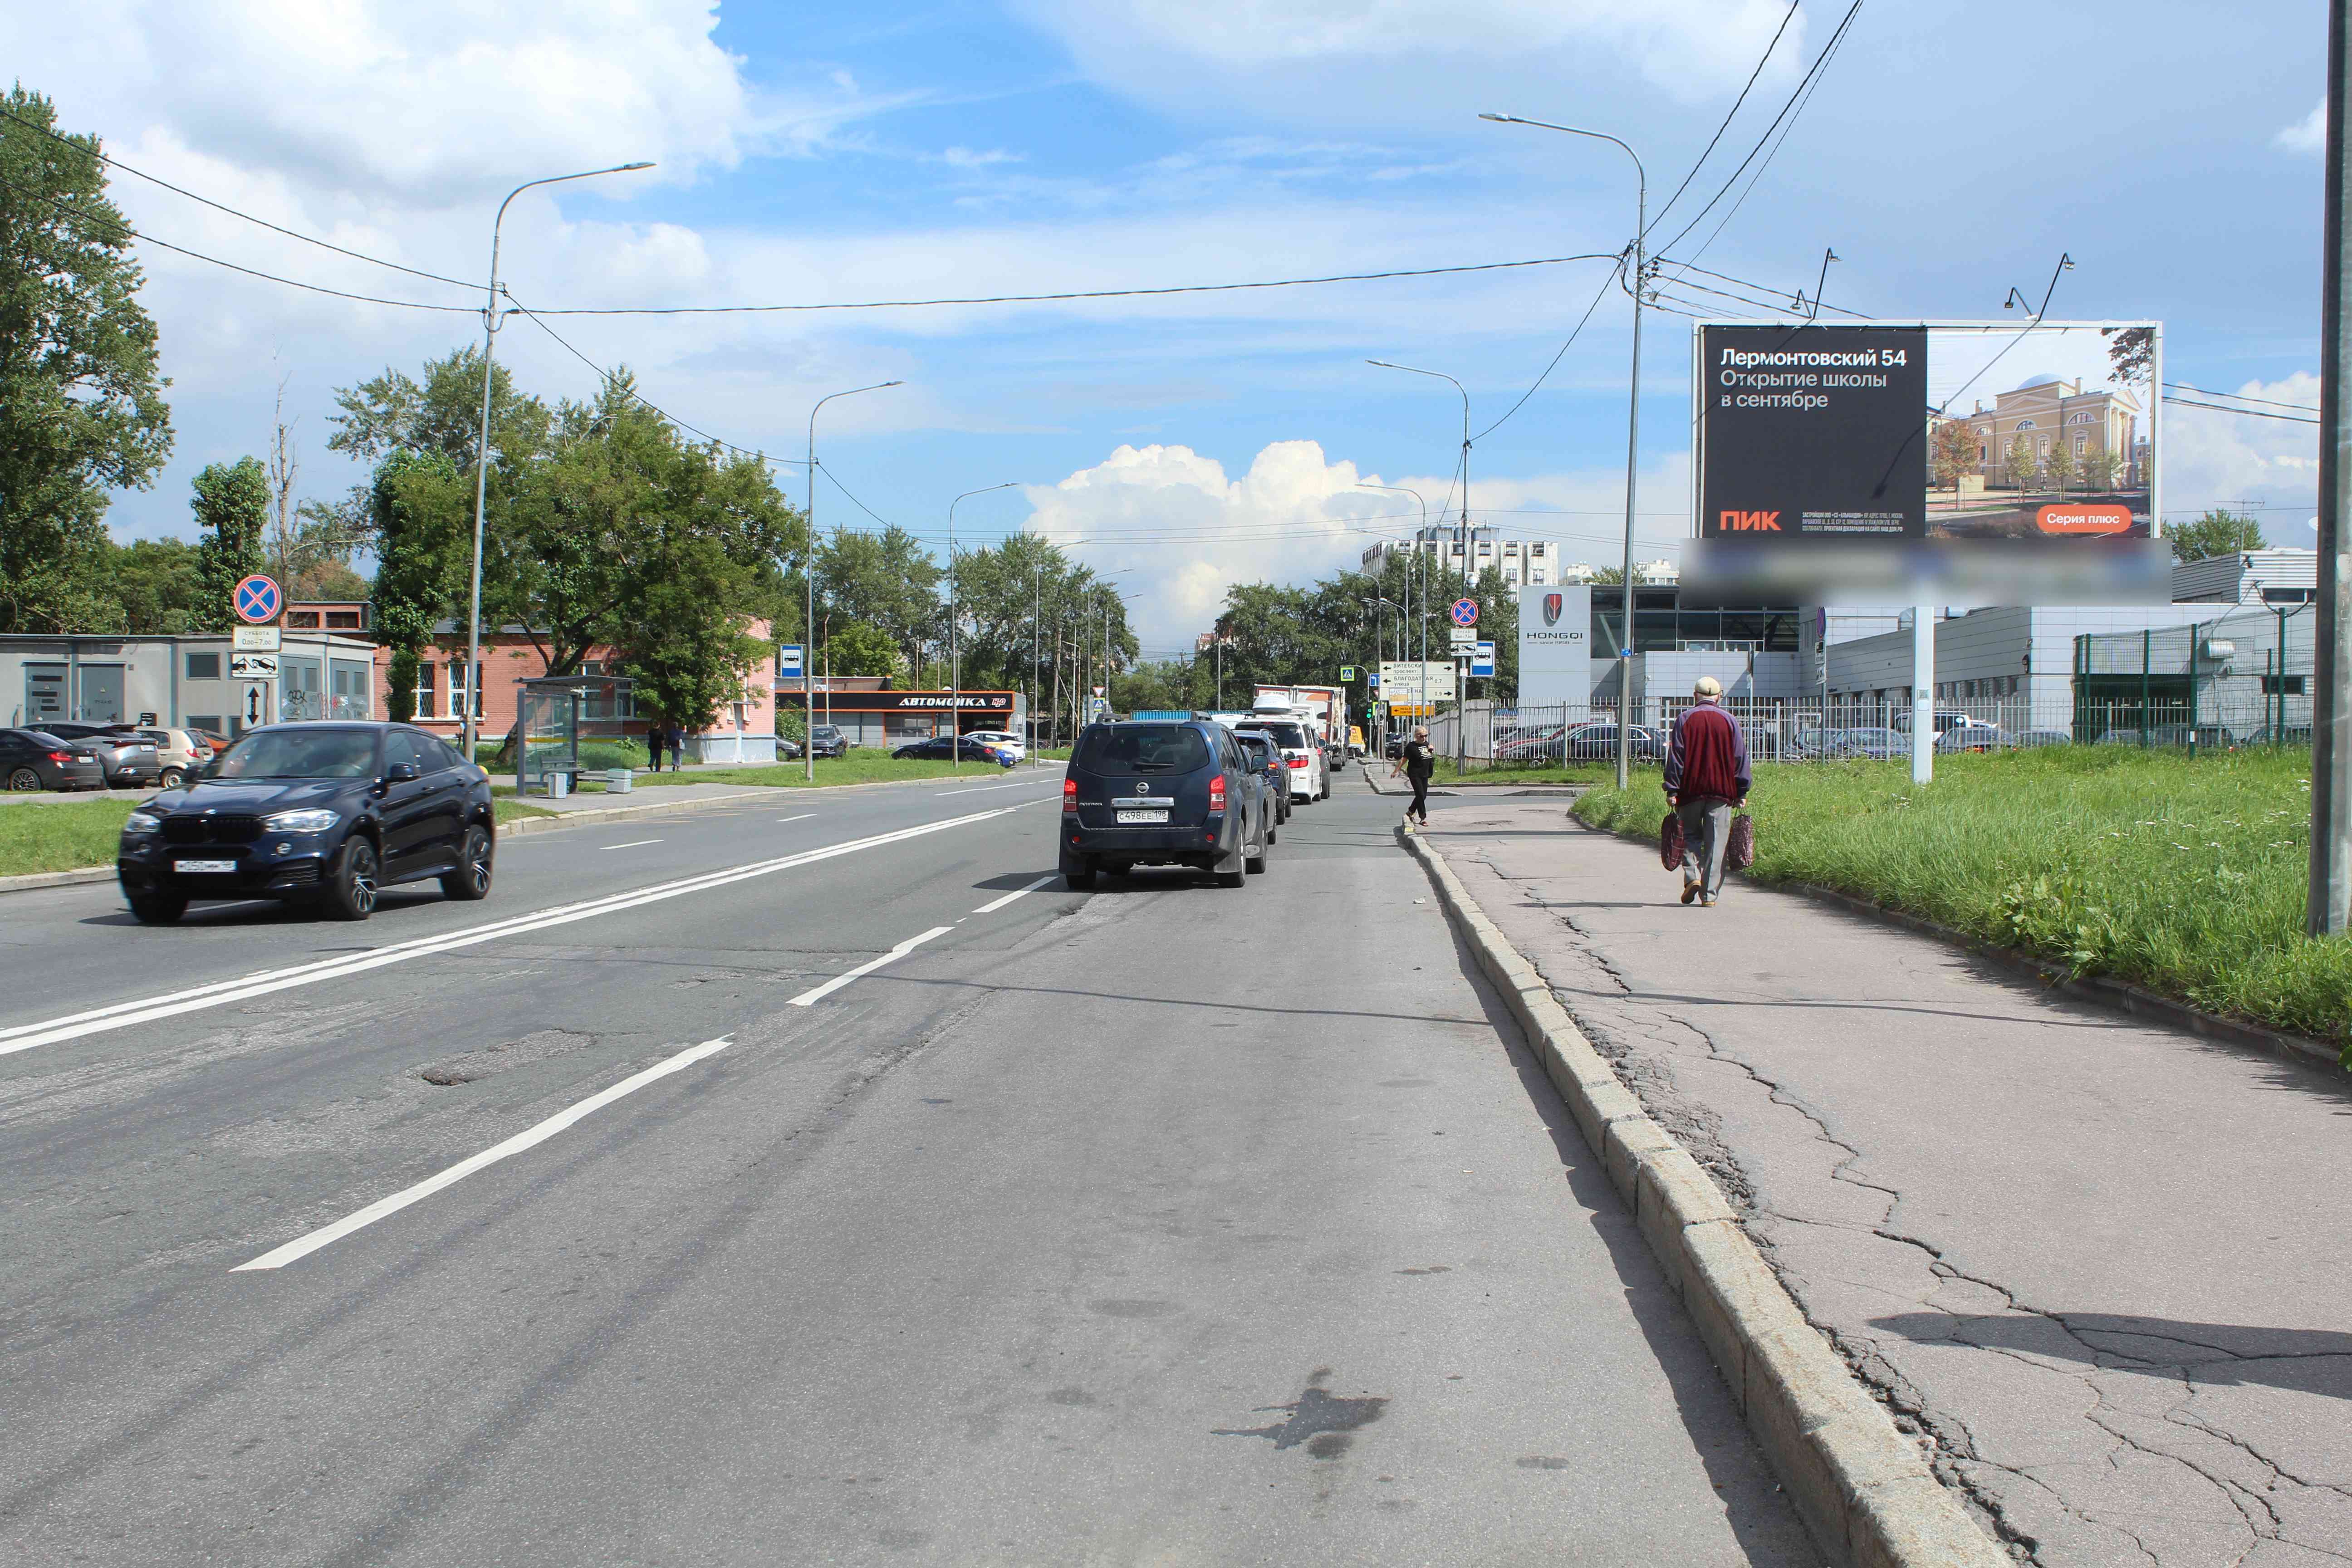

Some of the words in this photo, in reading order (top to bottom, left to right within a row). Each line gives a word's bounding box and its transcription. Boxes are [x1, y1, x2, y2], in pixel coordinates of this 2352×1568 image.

[1720, 348, 1877, 369] Лермонтовский
[1881, 350, 1907, 366] 54
[1720, 370, 1818, 389] Открытие
[1823, 374, 1886, 387] школы
[1721, 395, 1731, 407] в
[1736, 390, 1828, 411] сентябре
[1720, 511, 1781, 530] ПИК
[2047, 513, 2085, 525] Серия
[2088, 515, 2120, 524] плюс
[899, 696, 986, 706] АВТОМОЙКА
[1119, 811, 1152, 820] С498ЕЕ
